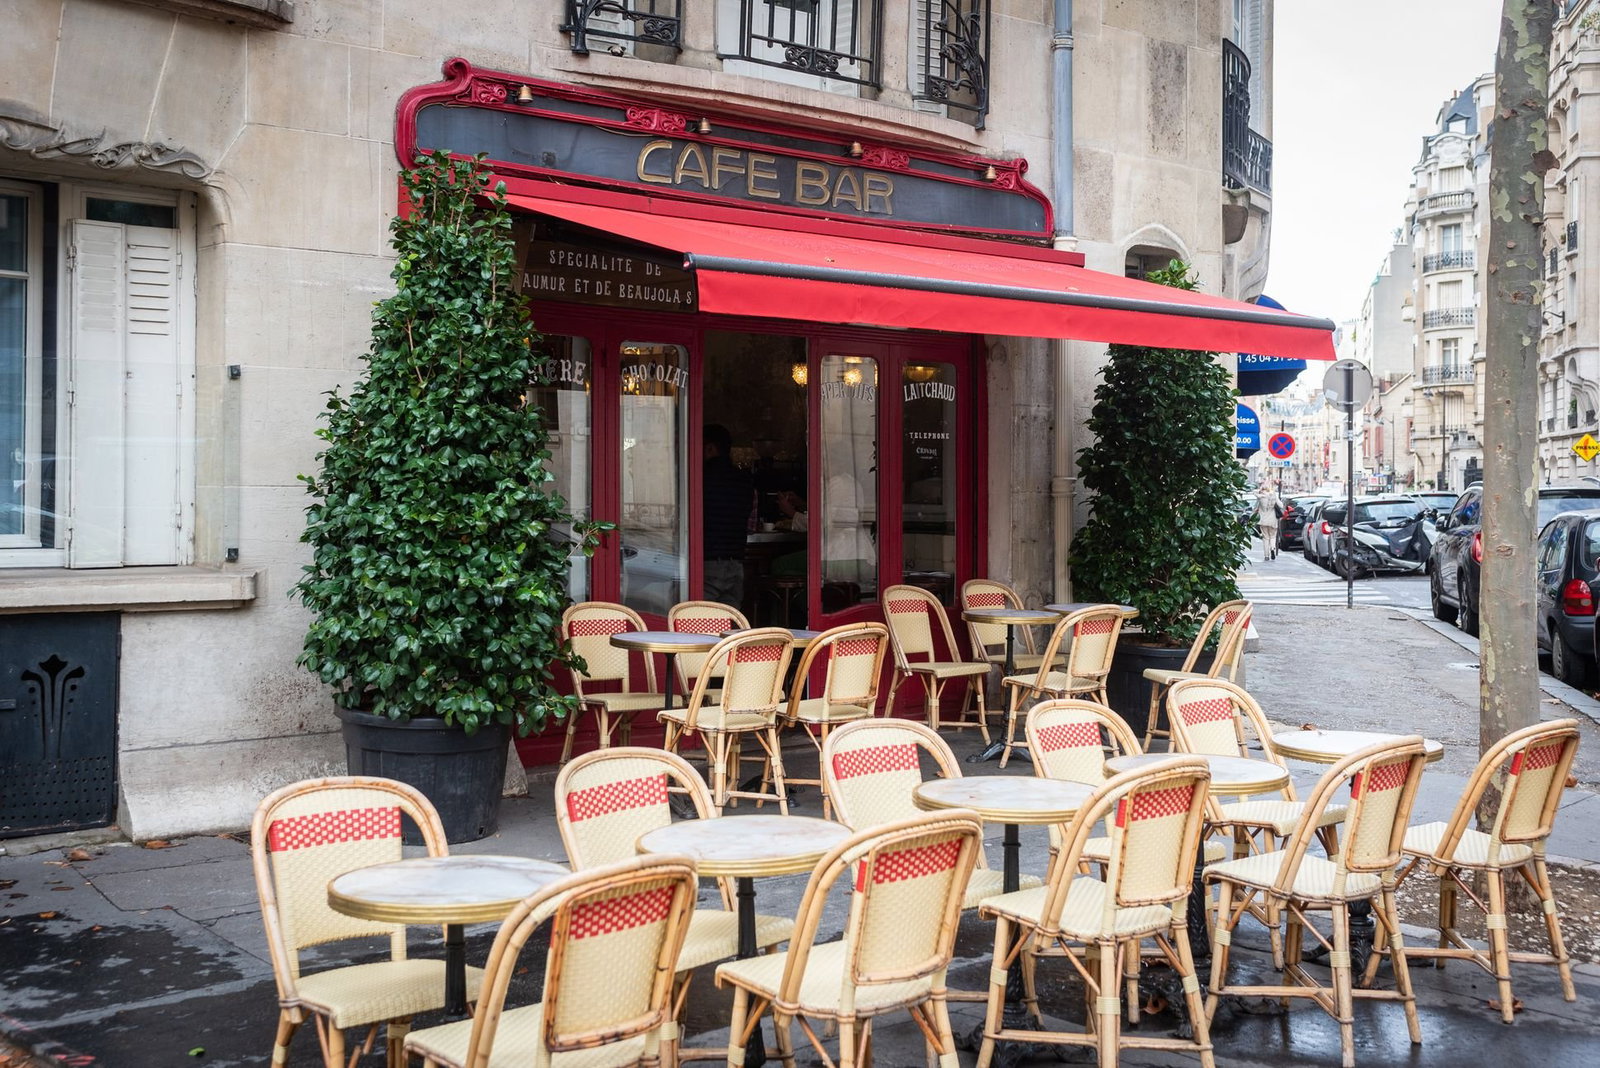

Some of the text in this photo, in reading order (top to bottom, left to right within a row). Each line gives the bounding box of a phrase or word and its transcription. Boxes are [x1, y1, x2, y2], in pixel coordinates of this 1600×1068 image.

[637, 140, 894, 215] CAFE BAR
[549, 249, 632, 273] SPECIALITE
[522, 272, 692, 304] AUMUR ET DE BEAUJOLAS
[1245, 354, 1257, 363] 45
[621, 362, 688, 388] CHOCOLAT
[909, 431, 950, 440] TELEPHONE
